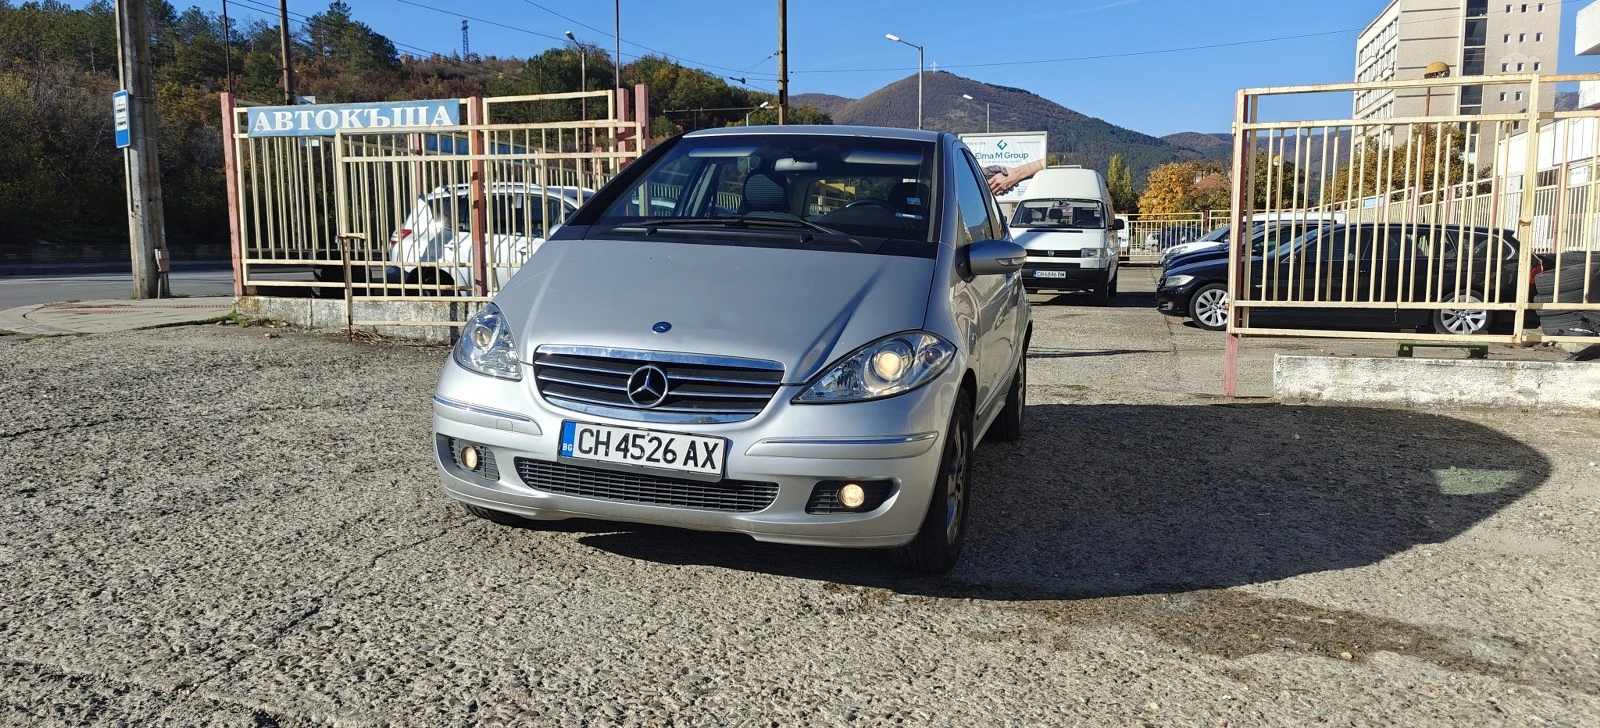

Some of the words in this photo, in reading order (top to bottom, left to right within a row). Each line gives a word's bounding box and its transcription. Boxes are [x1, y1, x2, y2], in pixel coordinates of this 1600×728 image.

[1004, 151, 1029, 160] Group
[562, 443, 573, 452] BG
[578, 428, 612, 457] CH
[614, 432, 678, 464] 4526
[682, 440, 719, 469] AX
